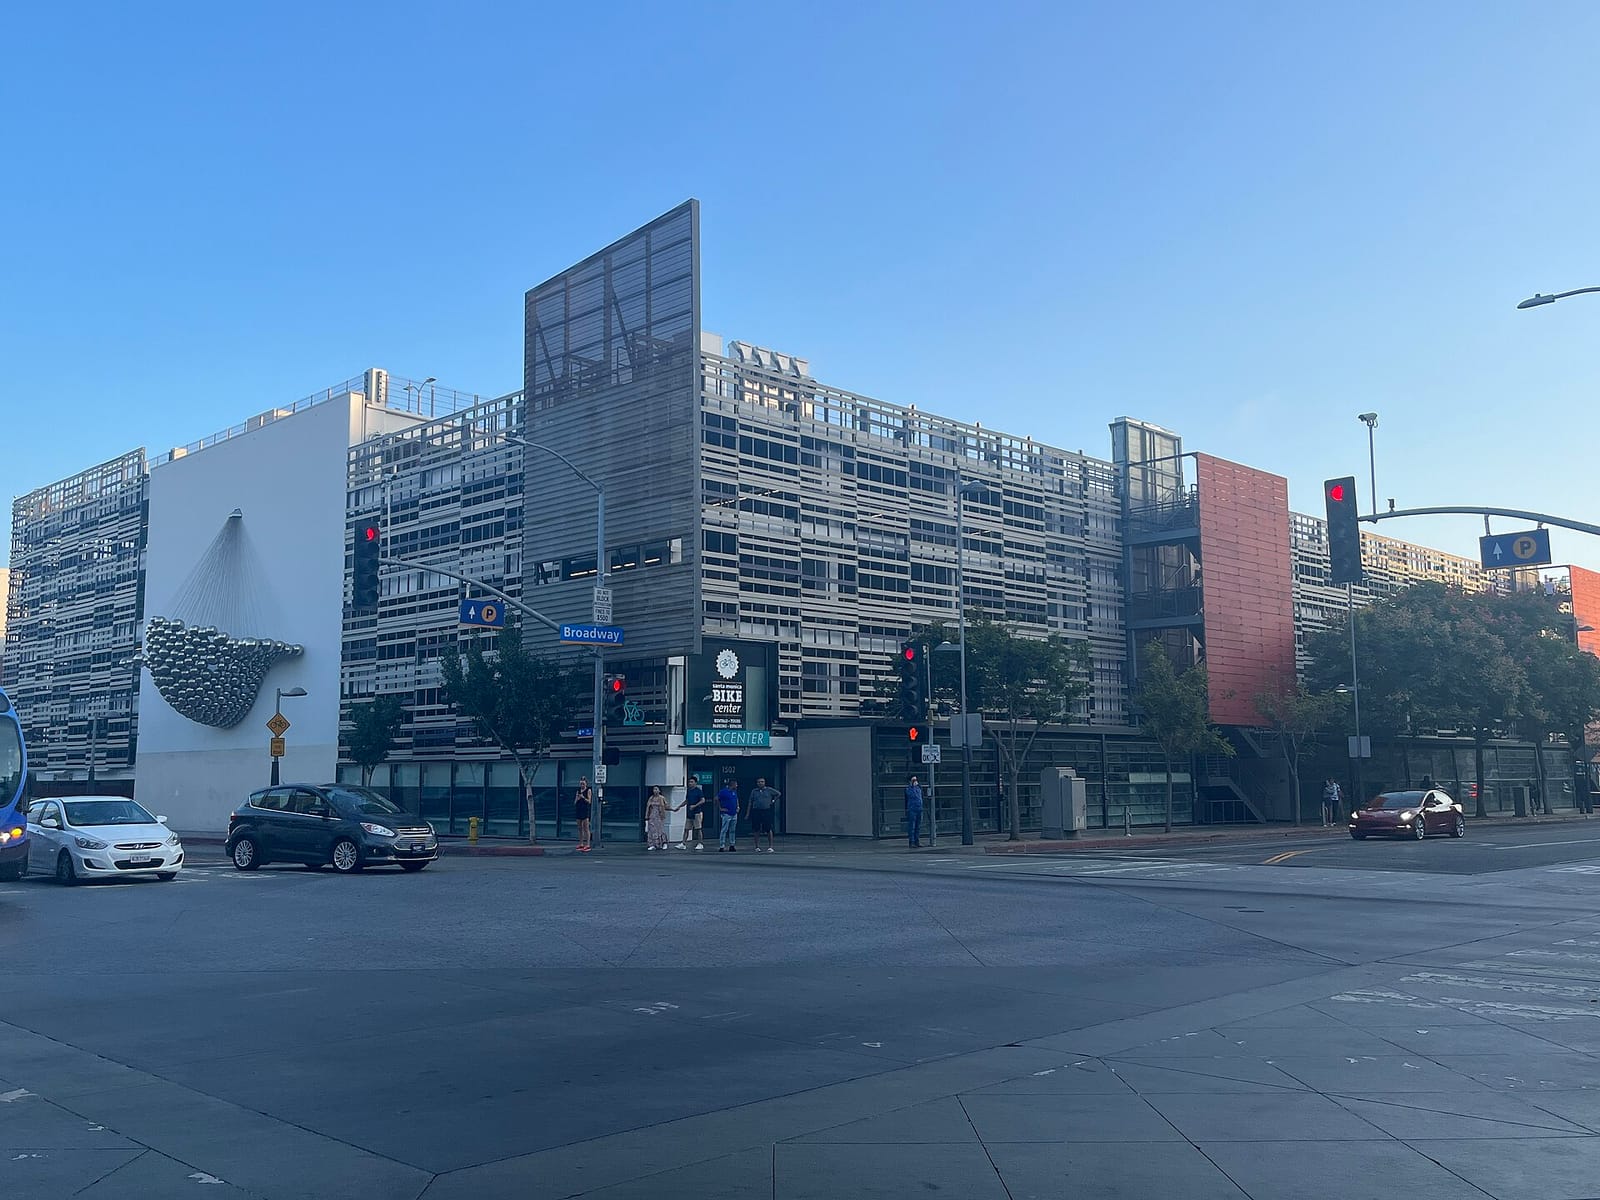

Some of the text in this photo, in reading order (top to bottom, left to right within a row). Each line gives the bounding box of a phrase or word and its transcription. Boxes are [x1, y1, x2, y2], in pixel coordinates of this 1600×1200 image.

[1520, 541, 1531, 554] P
[486, 608, 493, 619] P
[564, 626, 620, 642] Broadway
[712, 690, 742, 702] BIKE
[714, 704, 741, 713] center
[693, 732, 764, 744] BIKECENTER
